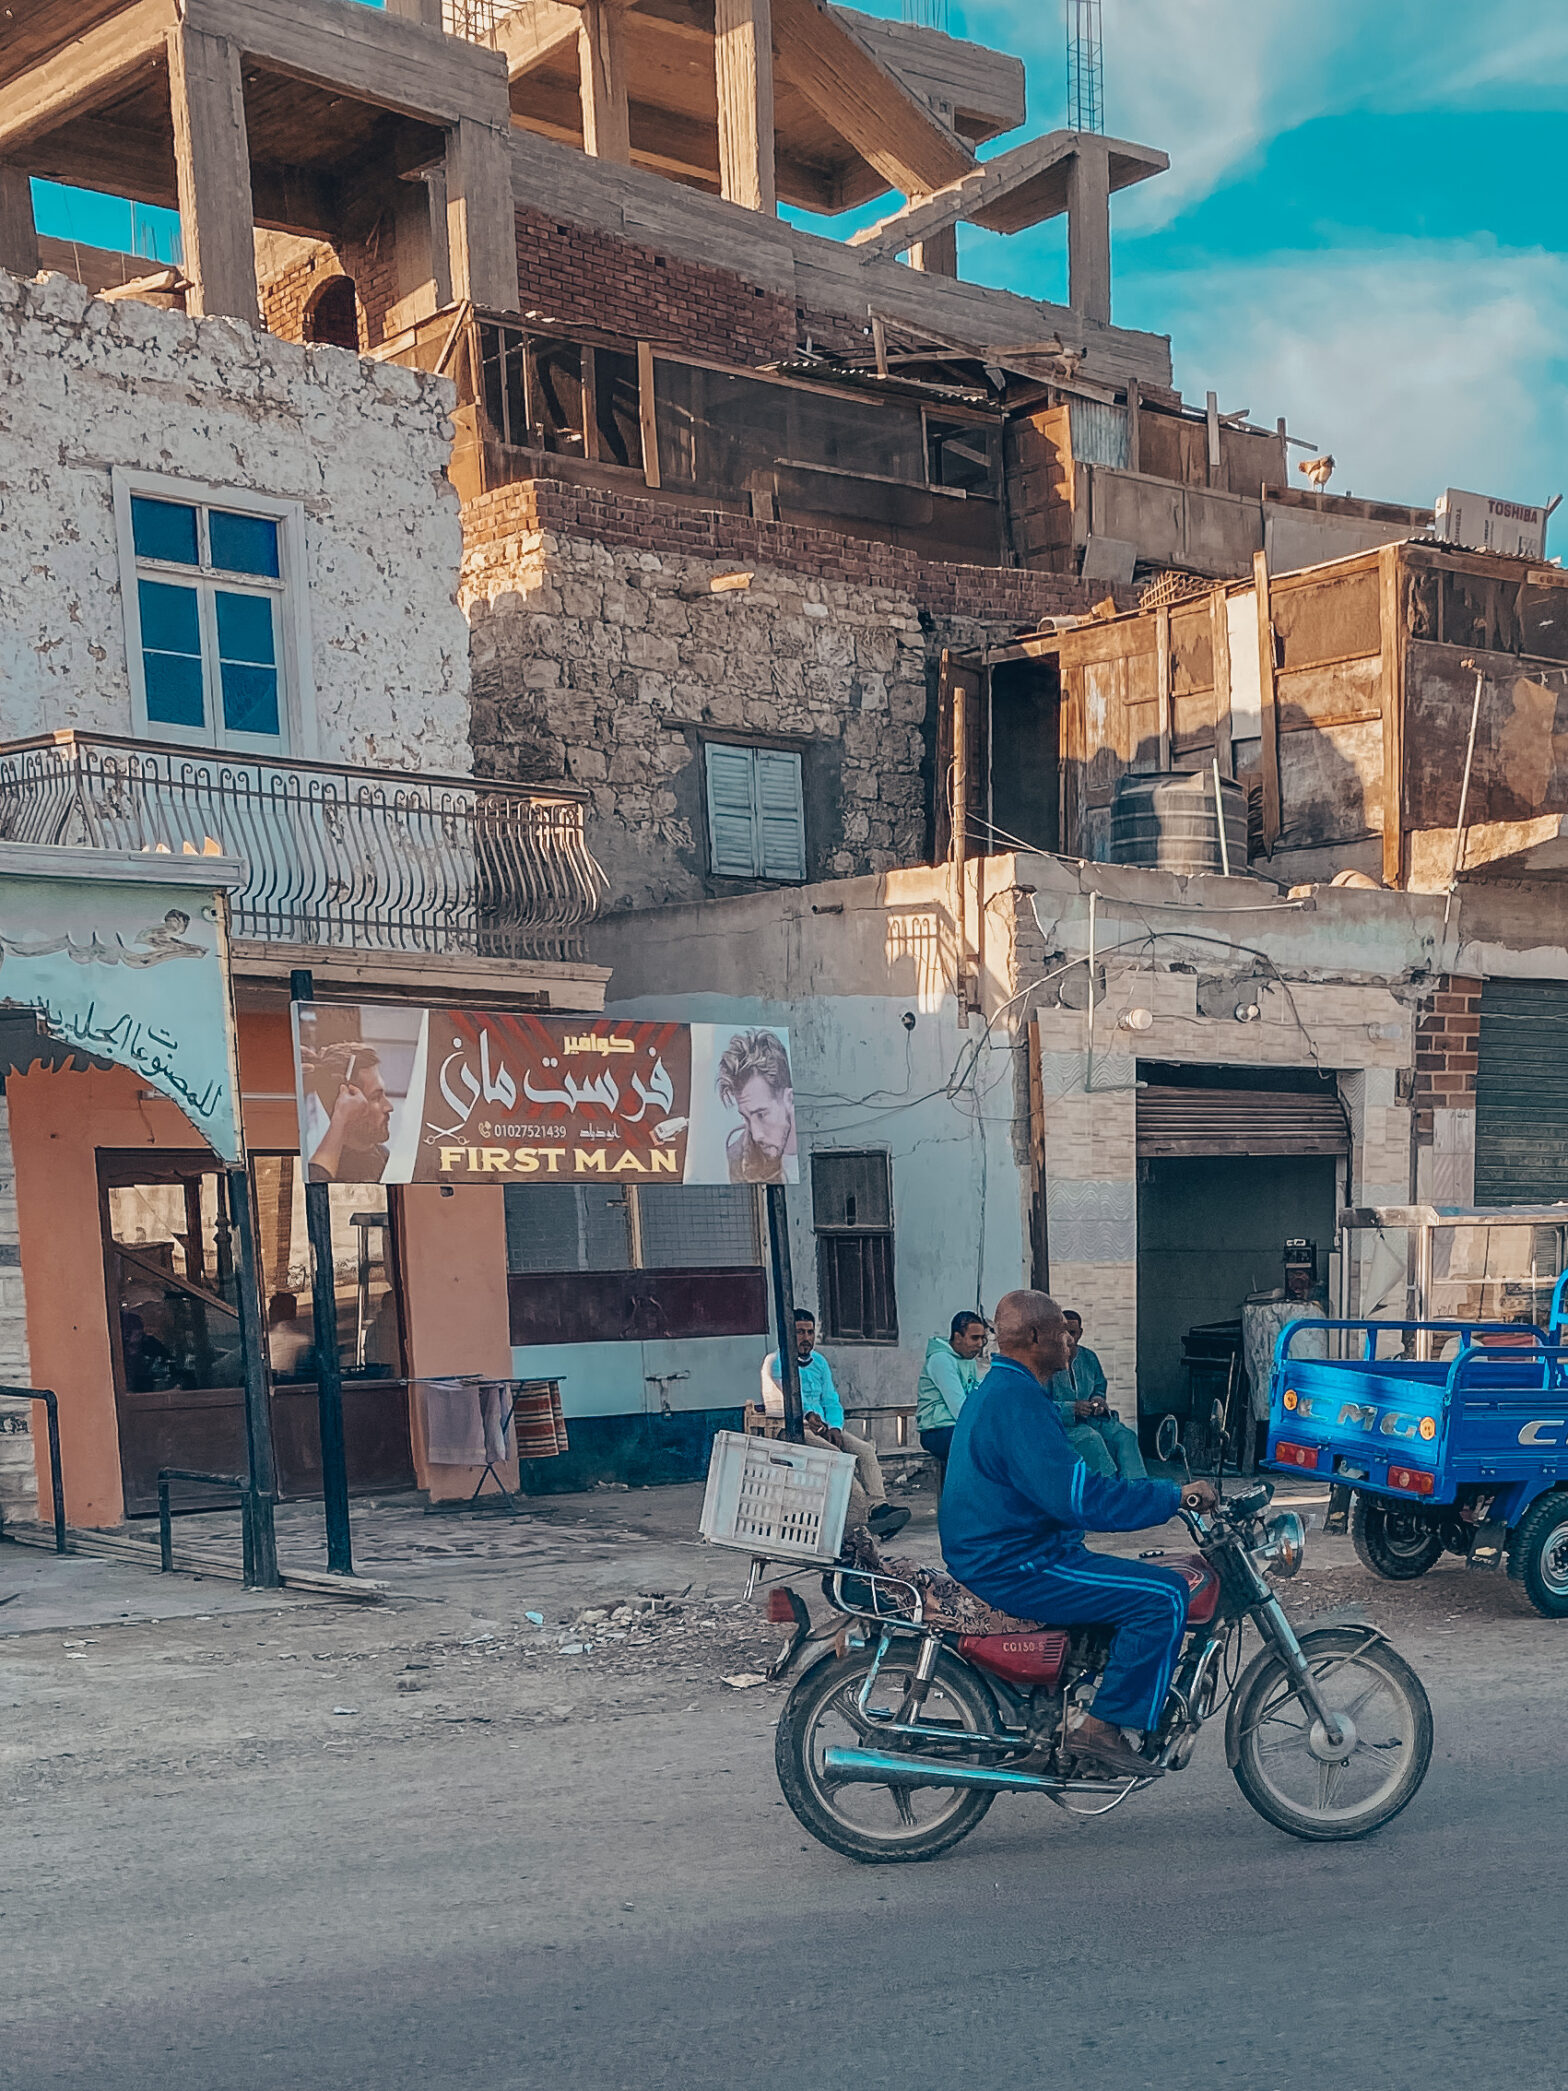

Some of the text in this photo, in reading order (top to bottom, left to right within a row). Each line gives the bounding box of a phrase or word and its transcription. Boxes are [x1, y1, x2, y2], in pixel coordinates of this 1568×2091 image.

[1487, 500, 1538, 524] TOSHIBA
[562, 1032, 636, 1057] كوافير
[439, 1028, 675, 1123] فرست مان
[494, 1124, 567, 1139] 01027521439
[439, 1146, 679, 1173] FIRST MAN
